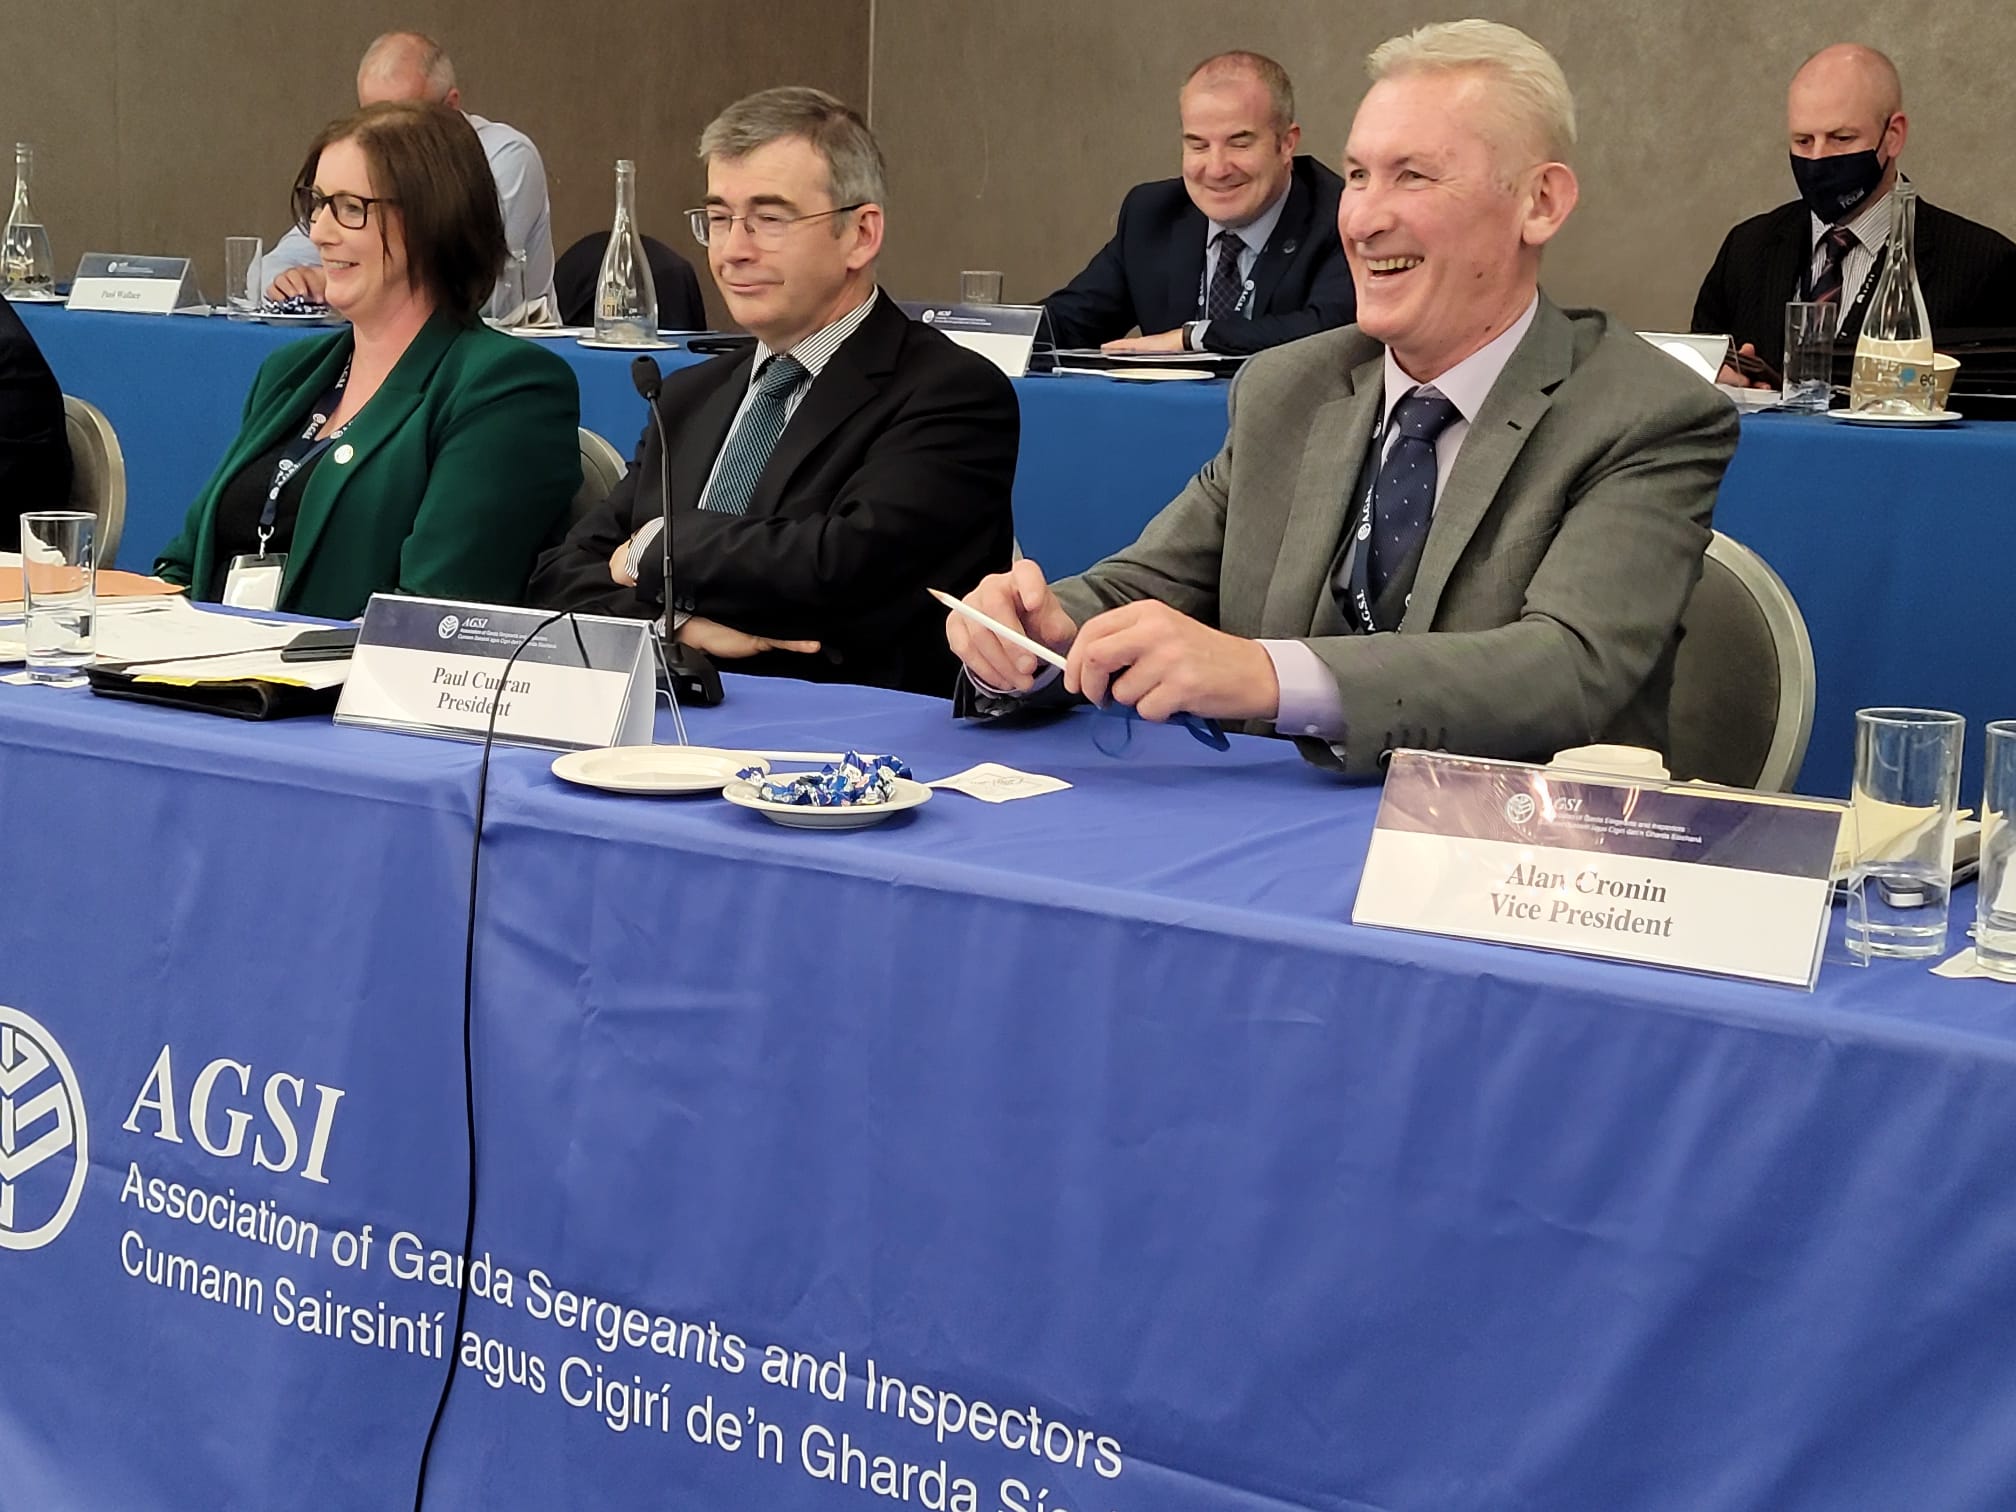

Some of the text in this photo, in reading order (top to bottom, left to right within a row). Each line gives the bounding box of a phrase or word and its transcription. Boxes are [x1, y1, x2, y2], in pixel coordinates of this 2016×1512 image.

[461, 617, 488, 629] AGSI
[432, 666, 531, 695] Paul Curran
[437, 691, 511, 717] President
[1551, 796, 1584, 812] GSI
[1505, 863, 1667, 903] Alan Cronin
[1490, 892, 1674, 938] Vice President
[122, 1044, 345, 1185] AGSI
[120, 1161, 1122, 1479] Association of Garda Sergeants and Inspectors
[120, 1230, 264, 1315] Cumann
[272, 1276, 446, 1359] Sairsintí
[459, 1330, 547, 1394] agus
[559, 1356, 672, 1433] Cigirí
[800, 1423, 977, 1512] Gharda
